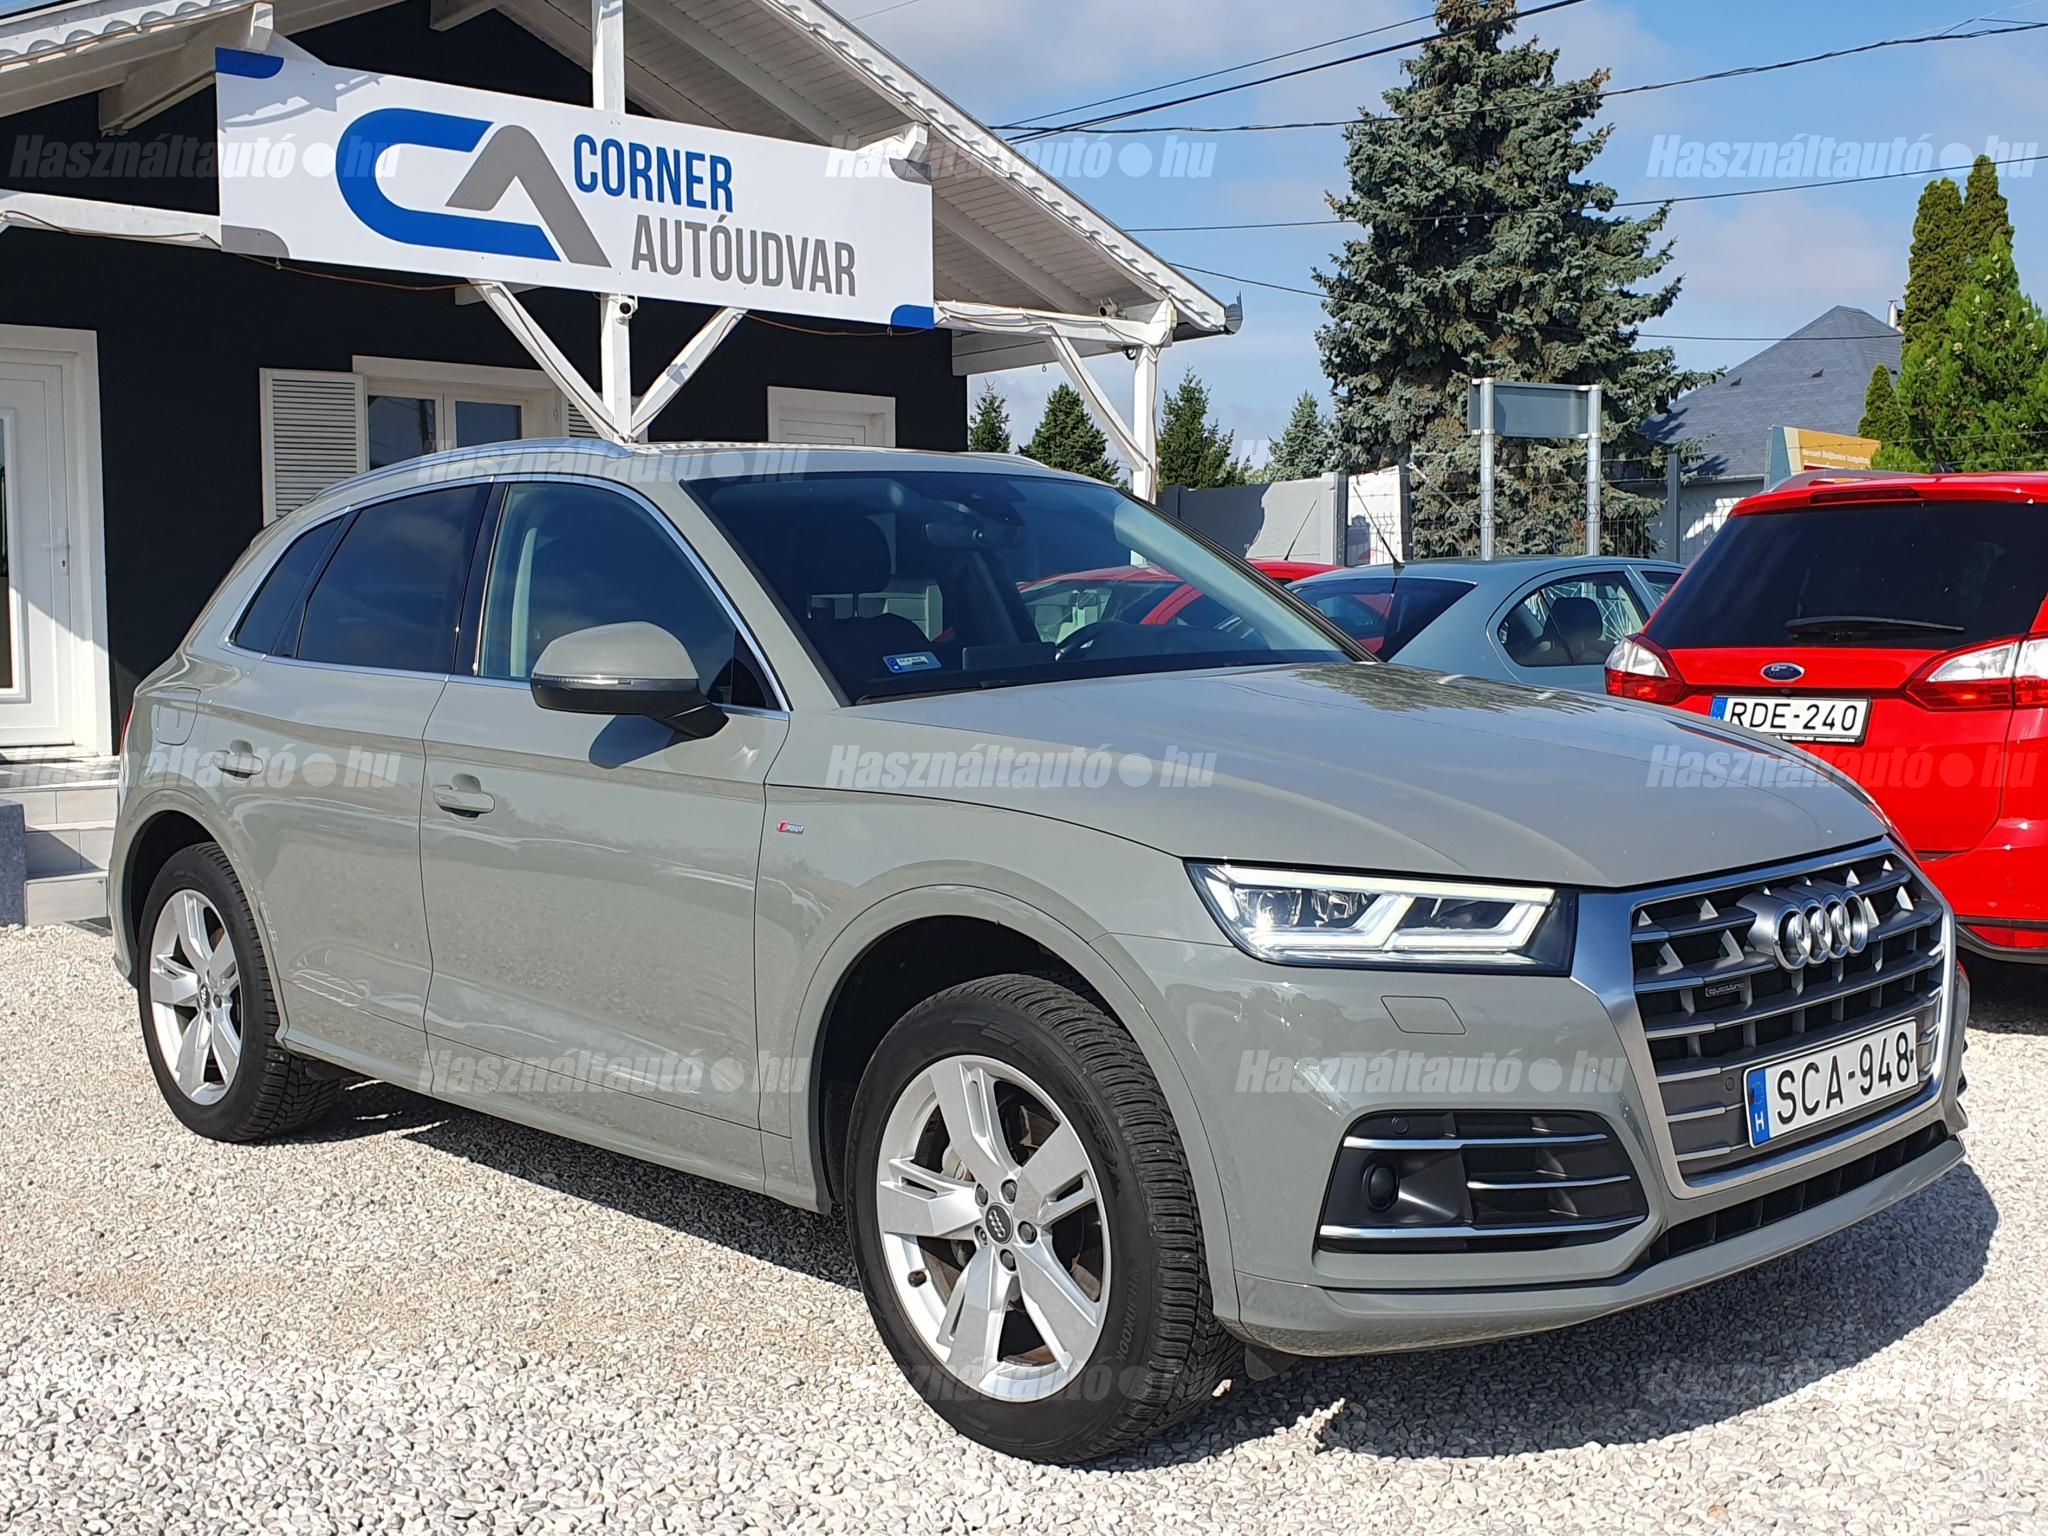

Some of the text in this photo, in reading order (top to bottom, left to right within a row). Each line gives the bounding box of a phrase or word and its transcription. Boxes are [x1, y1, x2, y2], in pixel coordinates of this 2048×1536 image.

[574, 134, 733, 212] CORNER
[631, 214, 856, 297] AUTÓUDVAR
[1730, 702, 1858, 731] RDE-240
[1776, 1031, 1911, 1125] SCA-948
[1754, 1111, 1765, 1133] H
